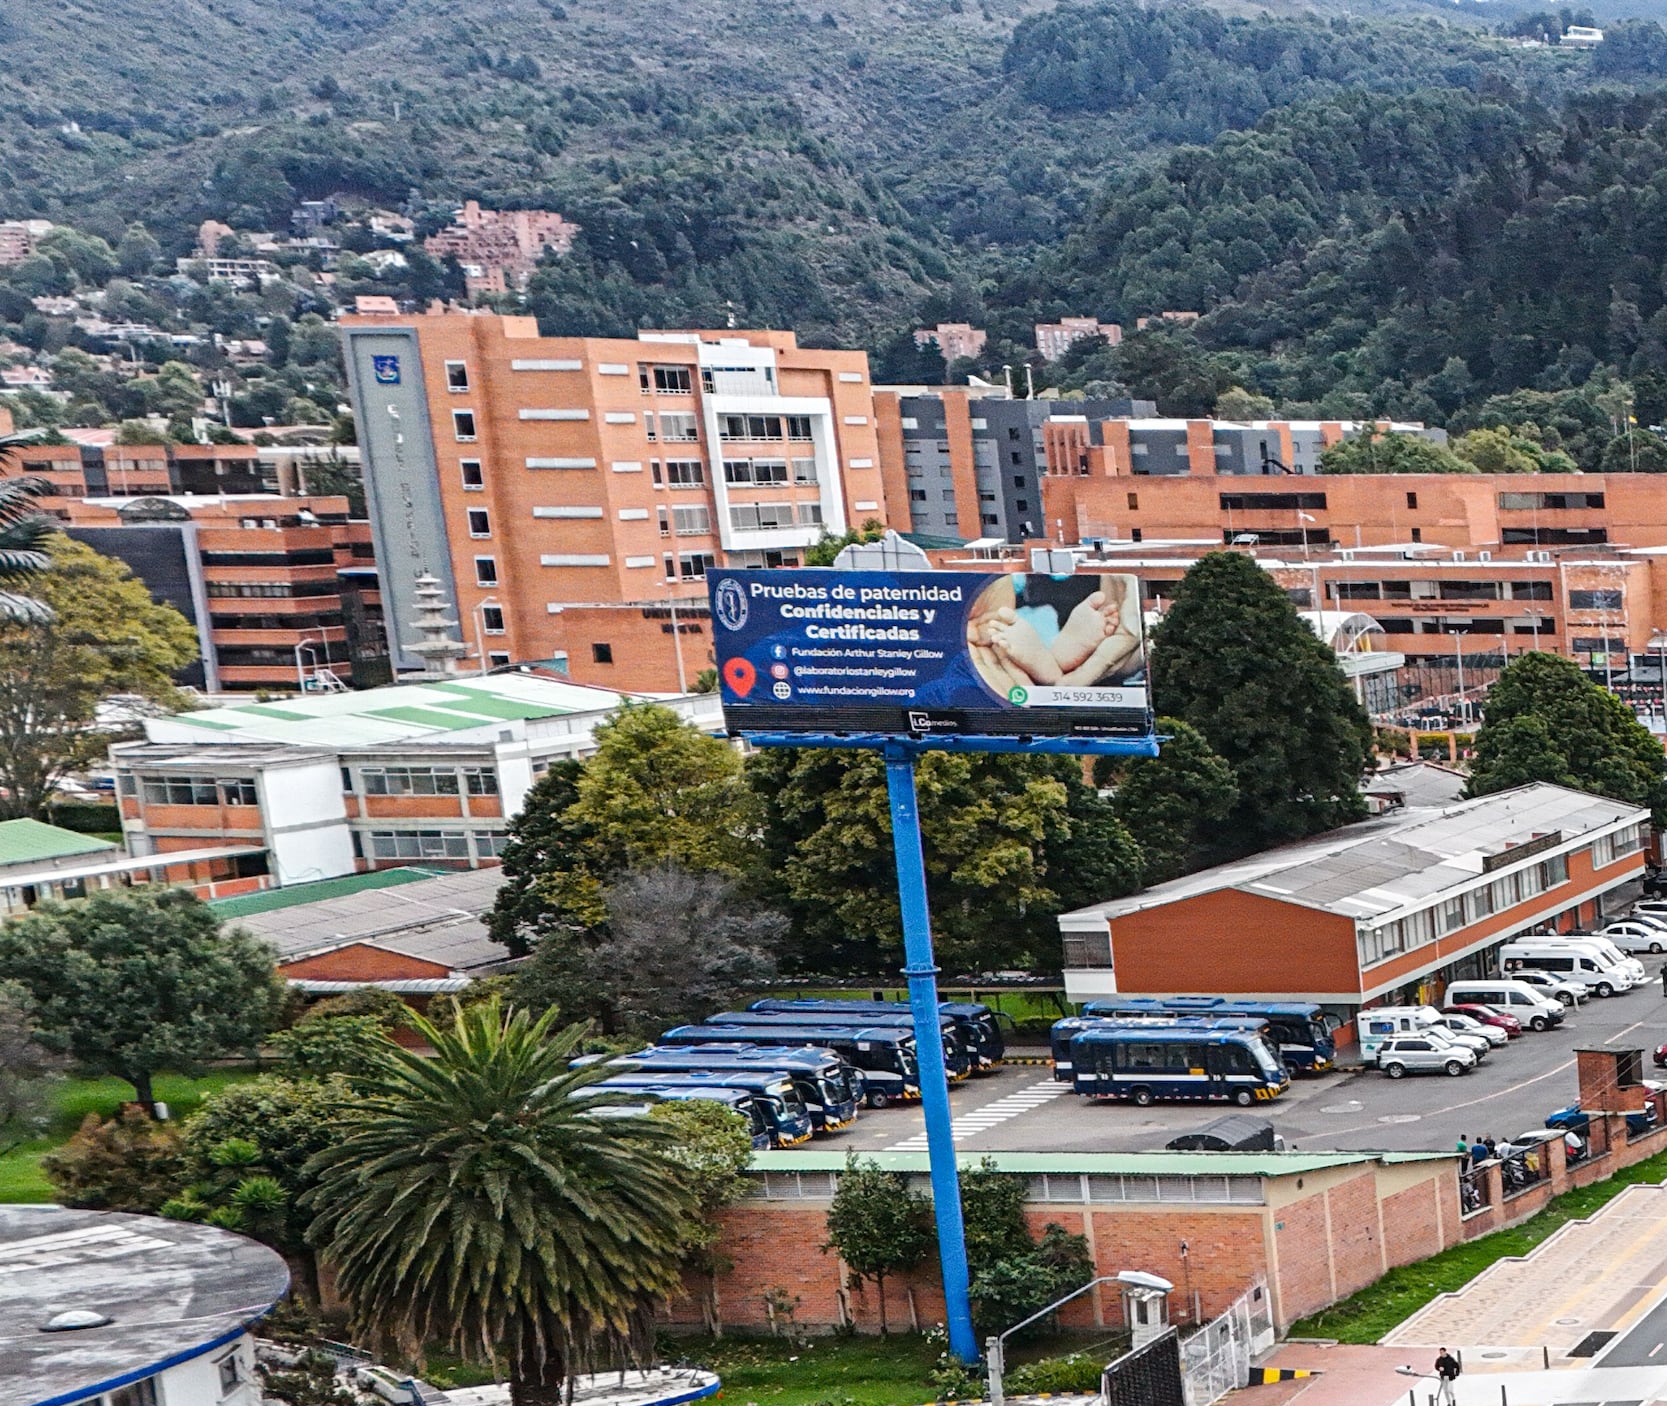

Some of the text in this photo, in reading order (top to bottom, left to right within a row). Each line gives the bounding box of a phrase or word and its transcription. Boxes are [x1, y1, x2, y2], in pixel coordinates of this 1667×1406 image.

[750, 583, 963, 604] Pruebas de paternidad
[780, 603, 936, 624] Confidenciales y
[805, 624, 920, 640] Certificadas
[792, 647, 944, 660] Fundación Arthur Stanley Gillow
[797, 685, 915, 697] www.fundaciongillow.org
[1052, 692, 1123, 703] 314 592 3639
